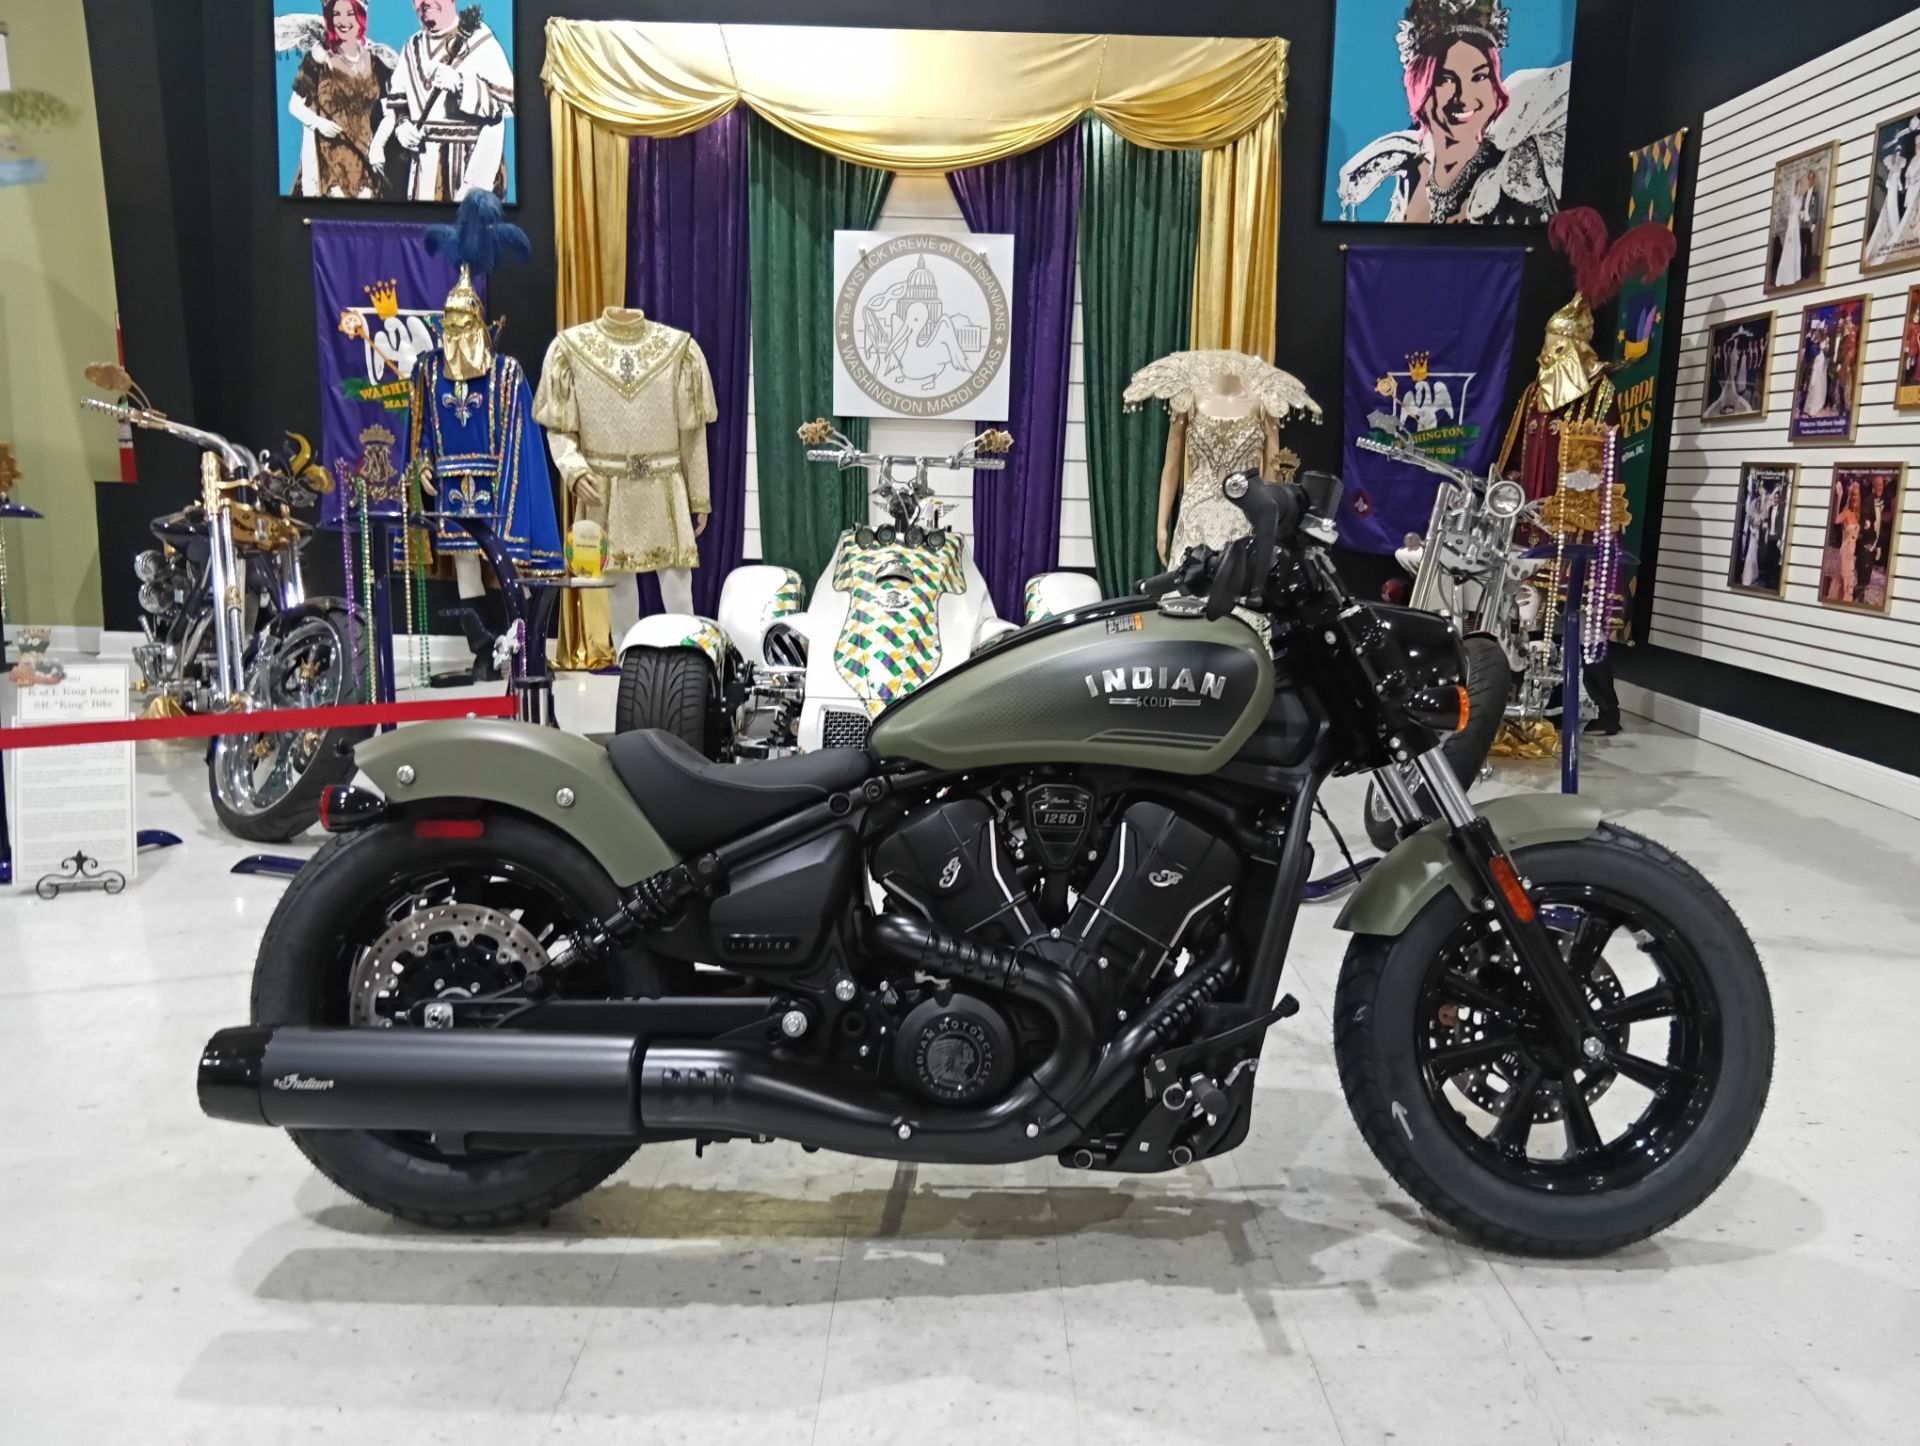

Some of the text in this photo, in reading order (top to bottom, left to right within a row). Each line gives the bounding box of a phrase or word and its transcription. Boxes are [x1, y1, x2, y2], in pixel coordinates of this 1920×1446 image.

[839, 237, 1006, 332] The MYSTICK KREWE of LOUISIANIANS
[841, 343, 1002, 413] WASHINGTON MARDI GRAS
[1620, 400, 1653, 439] RAS
[1084, 666, 1227, 700] INDIAN
[1136, 695, 1173, 708] SCOUT
[1043, 812, 1078, 825] 1250
[730, 941, 792, 951] LIMITED
[916, 1019, 993, 1086] INDIAN MOTORCYCLE
[275, 1073, 332, 1091] Indian
